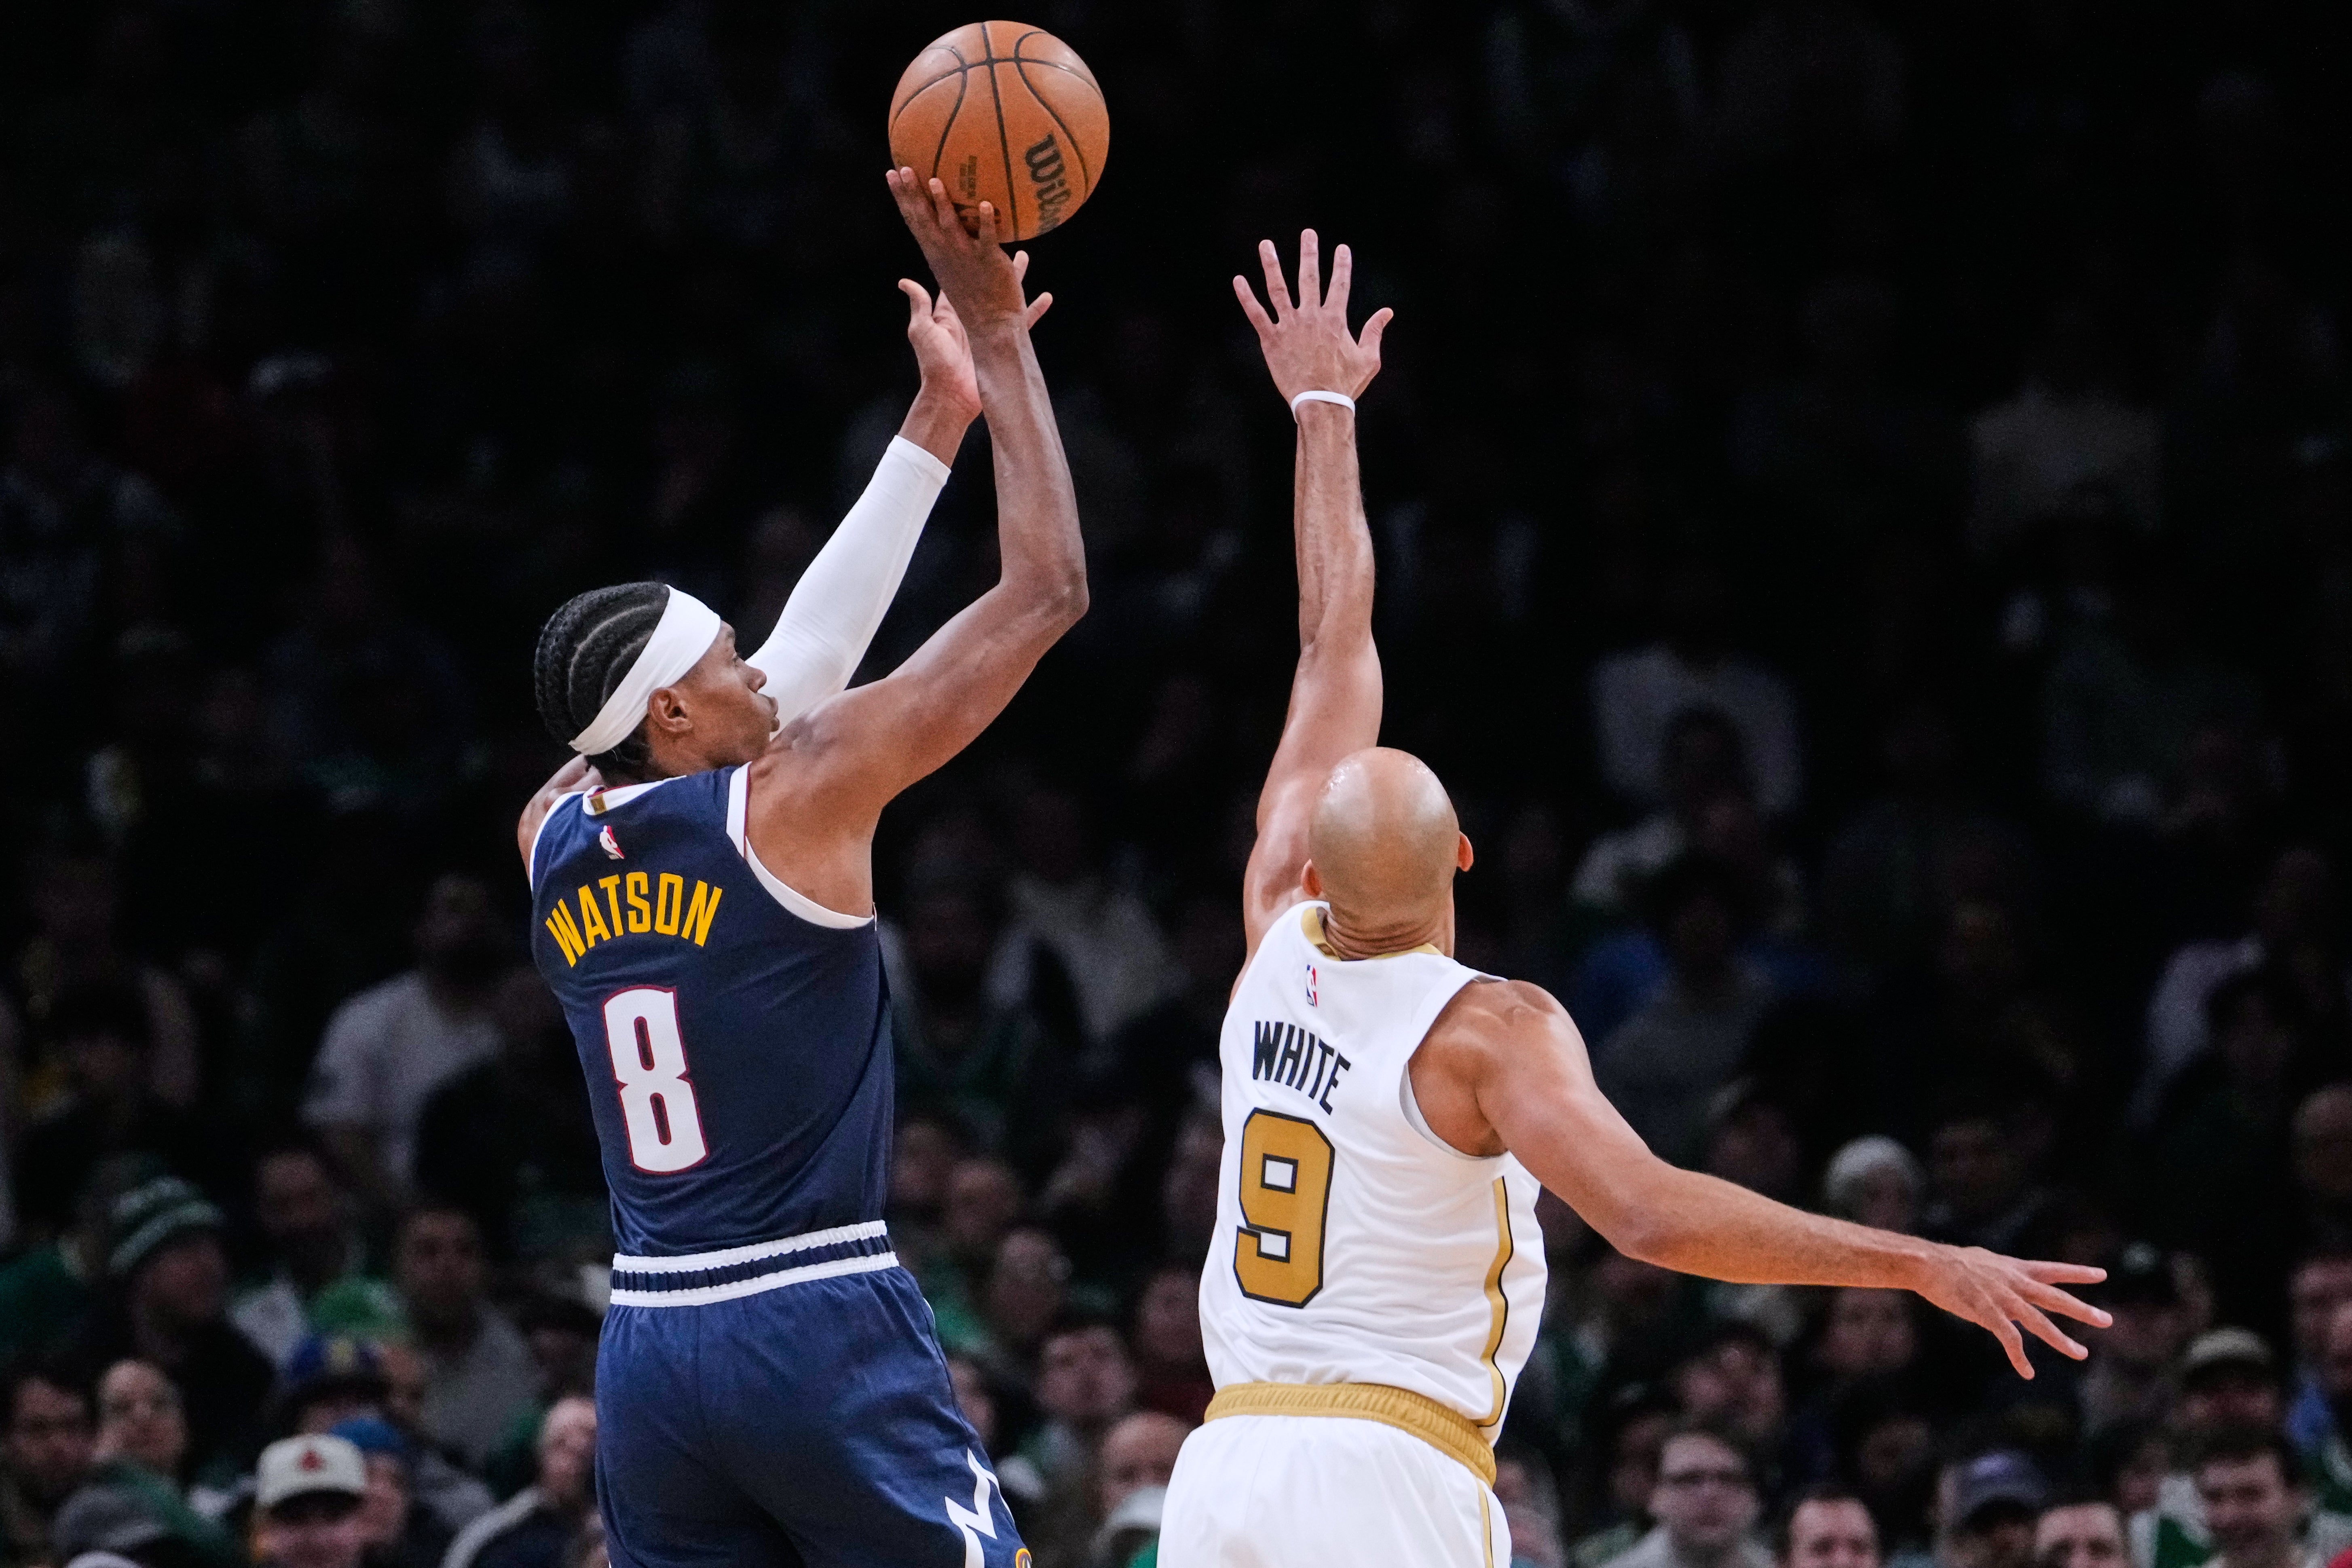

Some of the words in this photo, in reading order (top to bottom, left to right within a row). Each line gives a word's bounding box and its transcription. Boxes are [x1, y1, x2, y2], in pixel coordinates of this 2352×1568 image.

[1025, 133, 1071, 235] Wil
[545, 872, 723, 968] WATSON
[602, 984, 710, 1175] 8
[1253, 1020, 1351, 1116] WHITE
[1233, 1107, 1336, 1309] 9
